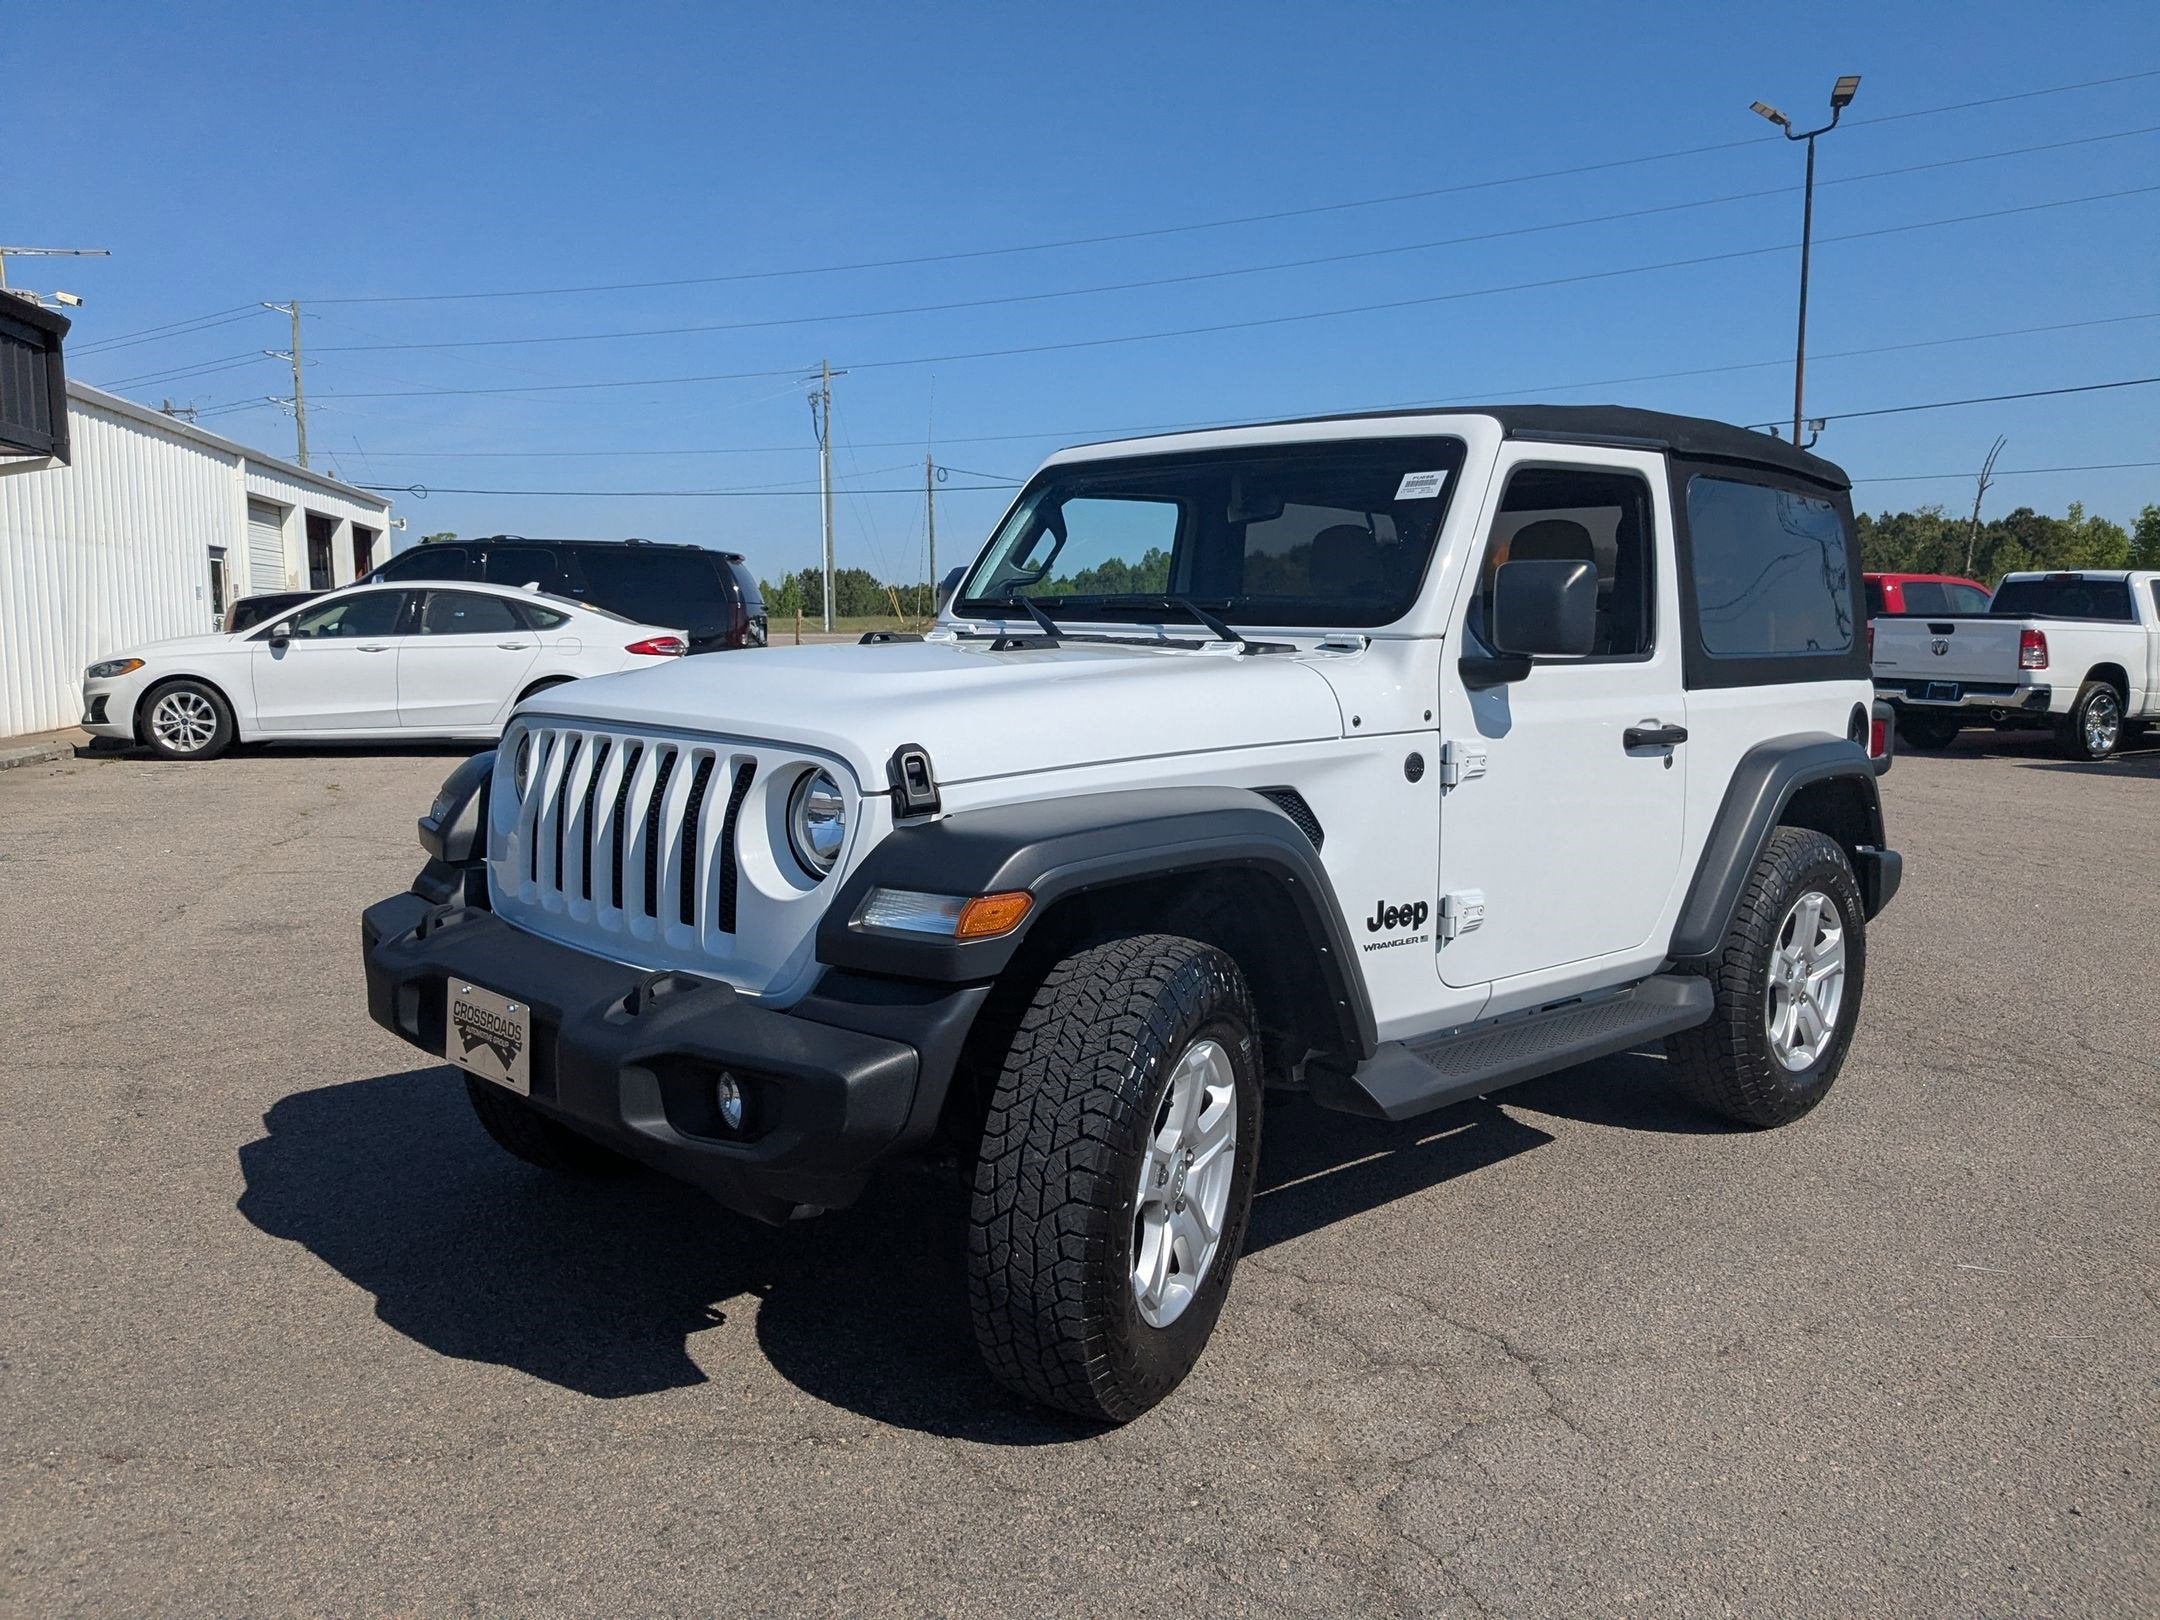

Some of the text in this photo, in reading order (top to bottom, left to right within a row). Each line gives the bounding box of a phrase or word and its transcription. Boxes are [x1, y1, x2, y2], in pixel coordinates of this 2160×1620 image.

[1366, 900, 1429, 932] Jeep
[1363, 936, 1419, 952] WRANGLER
[453, 1000, 522, 1041] CROSSROADS
